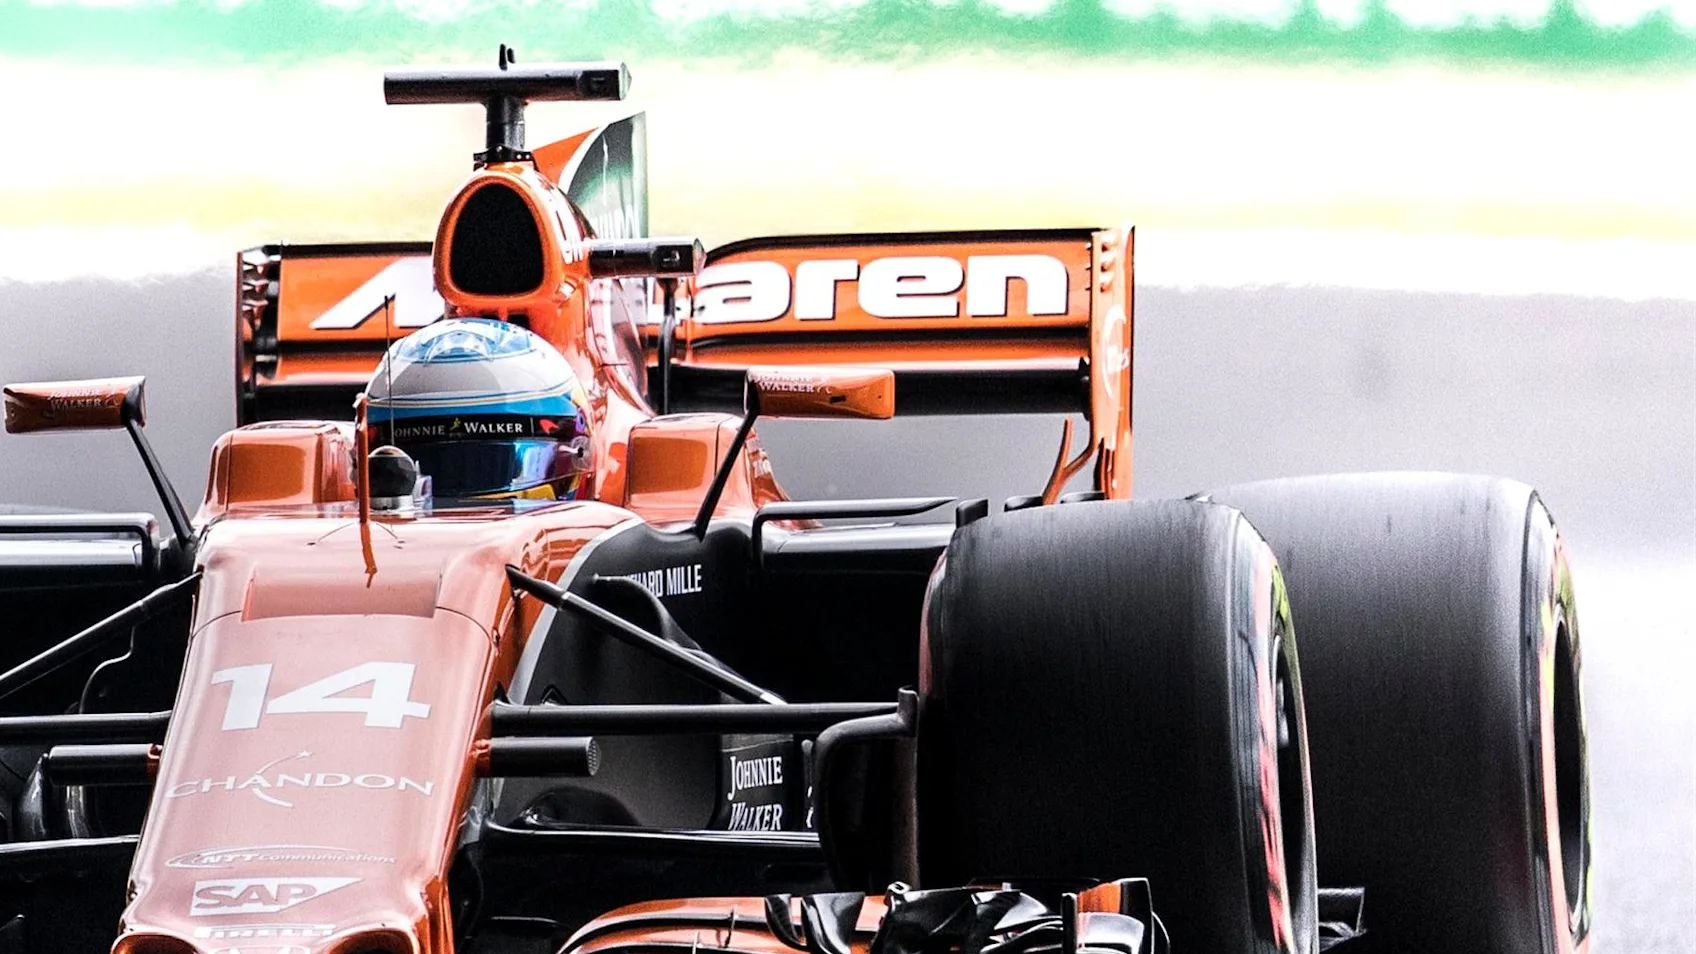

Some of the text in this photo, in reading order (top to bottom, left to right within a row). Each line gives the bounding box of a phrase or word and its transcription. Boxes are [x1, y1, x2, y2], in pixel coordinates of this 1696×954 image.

[759, 382, 815, 393] WALKER
[51, 399, 102, 410] WALKER
[394, 422, 523, 437] OHNNIE WALKER
[666, 564, 702, 596] MILLE
[211, 661, 432, 731] 14
[164, 772, 436, 798] CHANDON
[727, 756, 783, 801] JOHNNIE
[728, 802, 783, 831] WALKER
[203, 853, 257, 865] NTT
[195, 884, 318, 909] SAP
